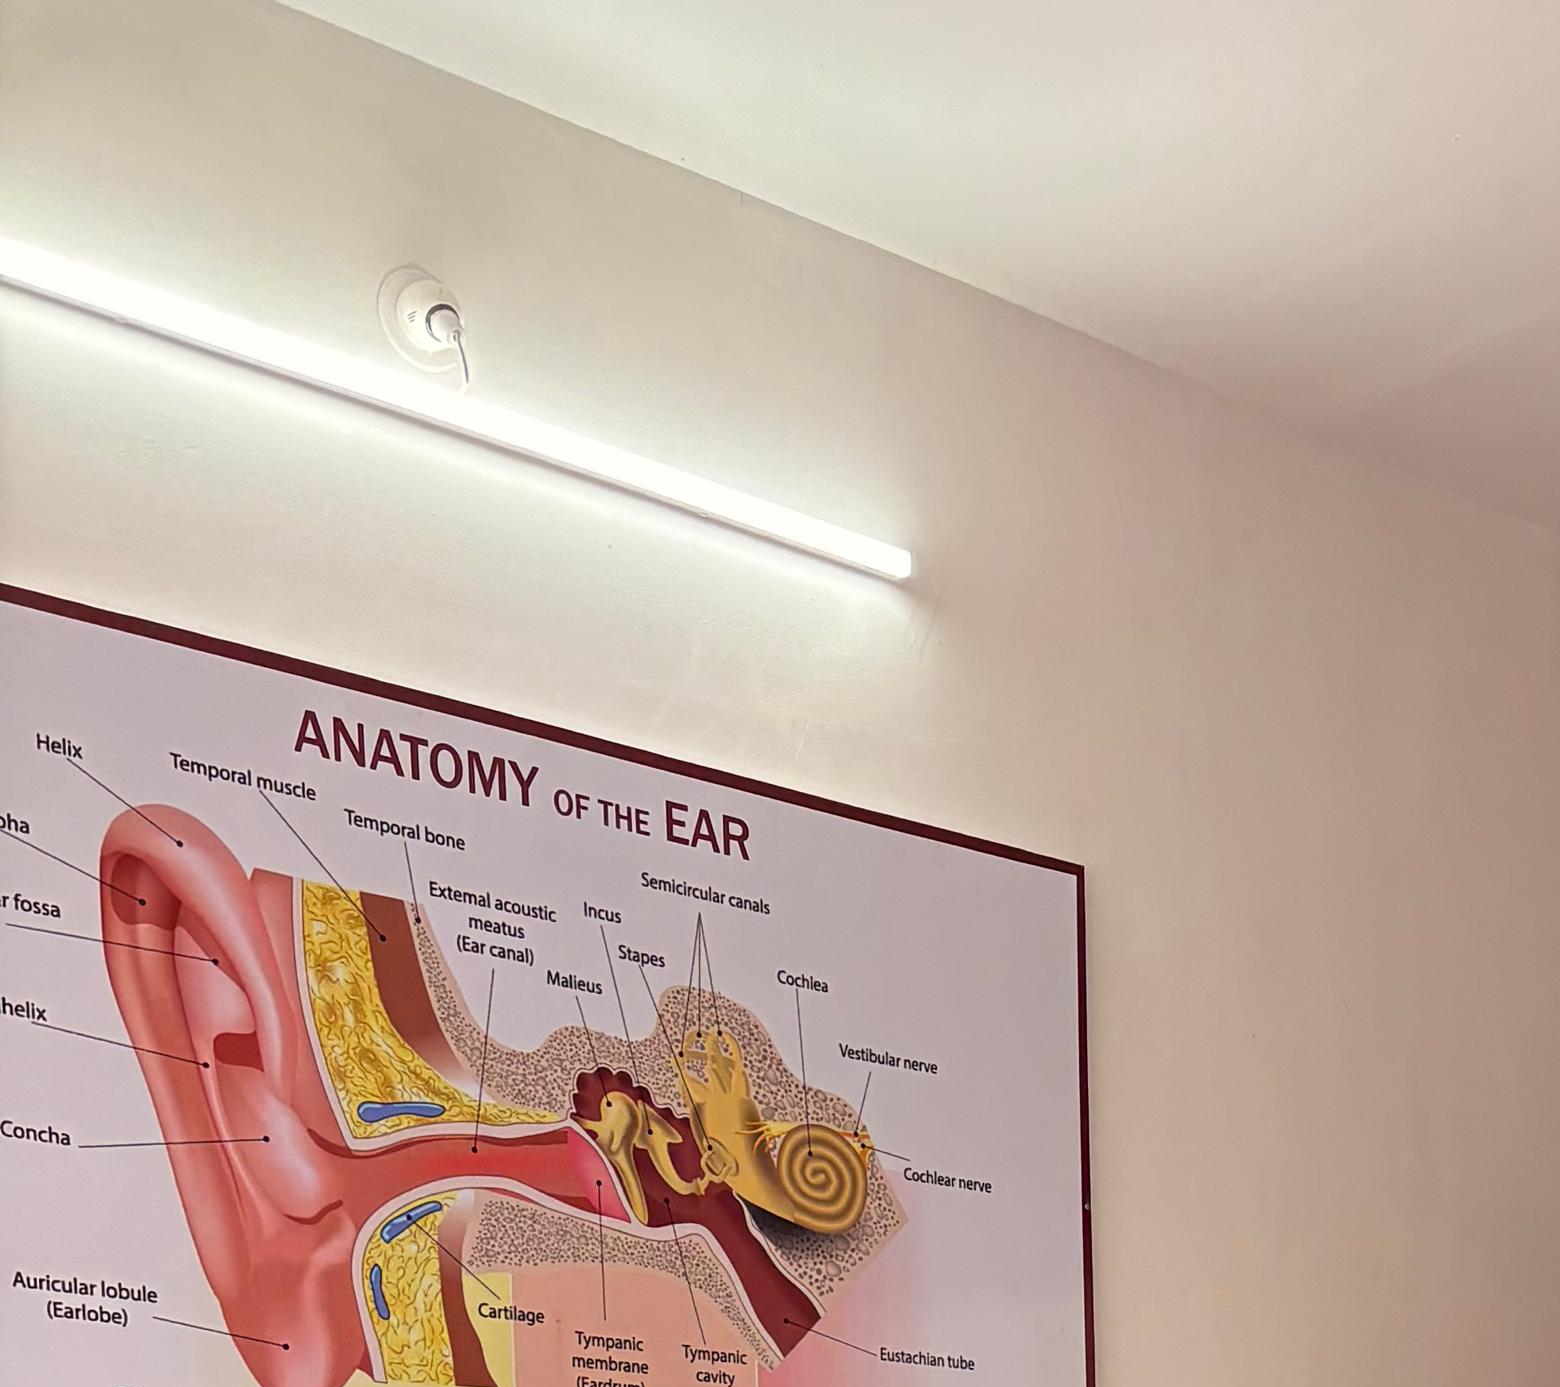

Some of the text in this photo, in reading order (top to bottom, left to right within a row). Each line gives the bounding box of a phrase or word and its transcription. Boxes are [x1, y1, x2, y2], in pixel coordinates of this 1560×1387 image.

[36, 733, 83, 760] Helix
[169, 751, 317, 801] Temporal muscle
[294, 709, 750, 861] ANATOMY OF THE EAR
[344, 808, 466, 852] Temporal bone
[13, 893, 61, 918] fossa
[641, 872, 771, 916] Semicircular canals
[495, 897, 557, 923] acoustic
[584, 901, 622, 924] Incus
[469, 917, 525, 939] meatus
[457, 934, 534, 967] (Ear canal)
[618, 944, 665, 968] Stapes
[777, 969, 830, 995] Cochlea
[0, 996, 47, 1022] helix
[839, 1043, 938, 1075] Vestibular nerve
[0, 1120, 71, 1145] Concha
[904, 1168, 992, 1194] Cochlear nerve
[12, 1271, 158, 1305] Auricular lobule
[46, 1300, 129, 1328] (Earlobe)
[478, 1303, 545, 1326] Cartilage
[575, 1331, 644, 1353] Tympanic
[572, 1354, 649, 1377] membrane
[682, 1344, 748, 1367] Tympanic
[880, 1348, 976, 1371] Eustachian tube
[696, 1368, 735, 1387] cavity
